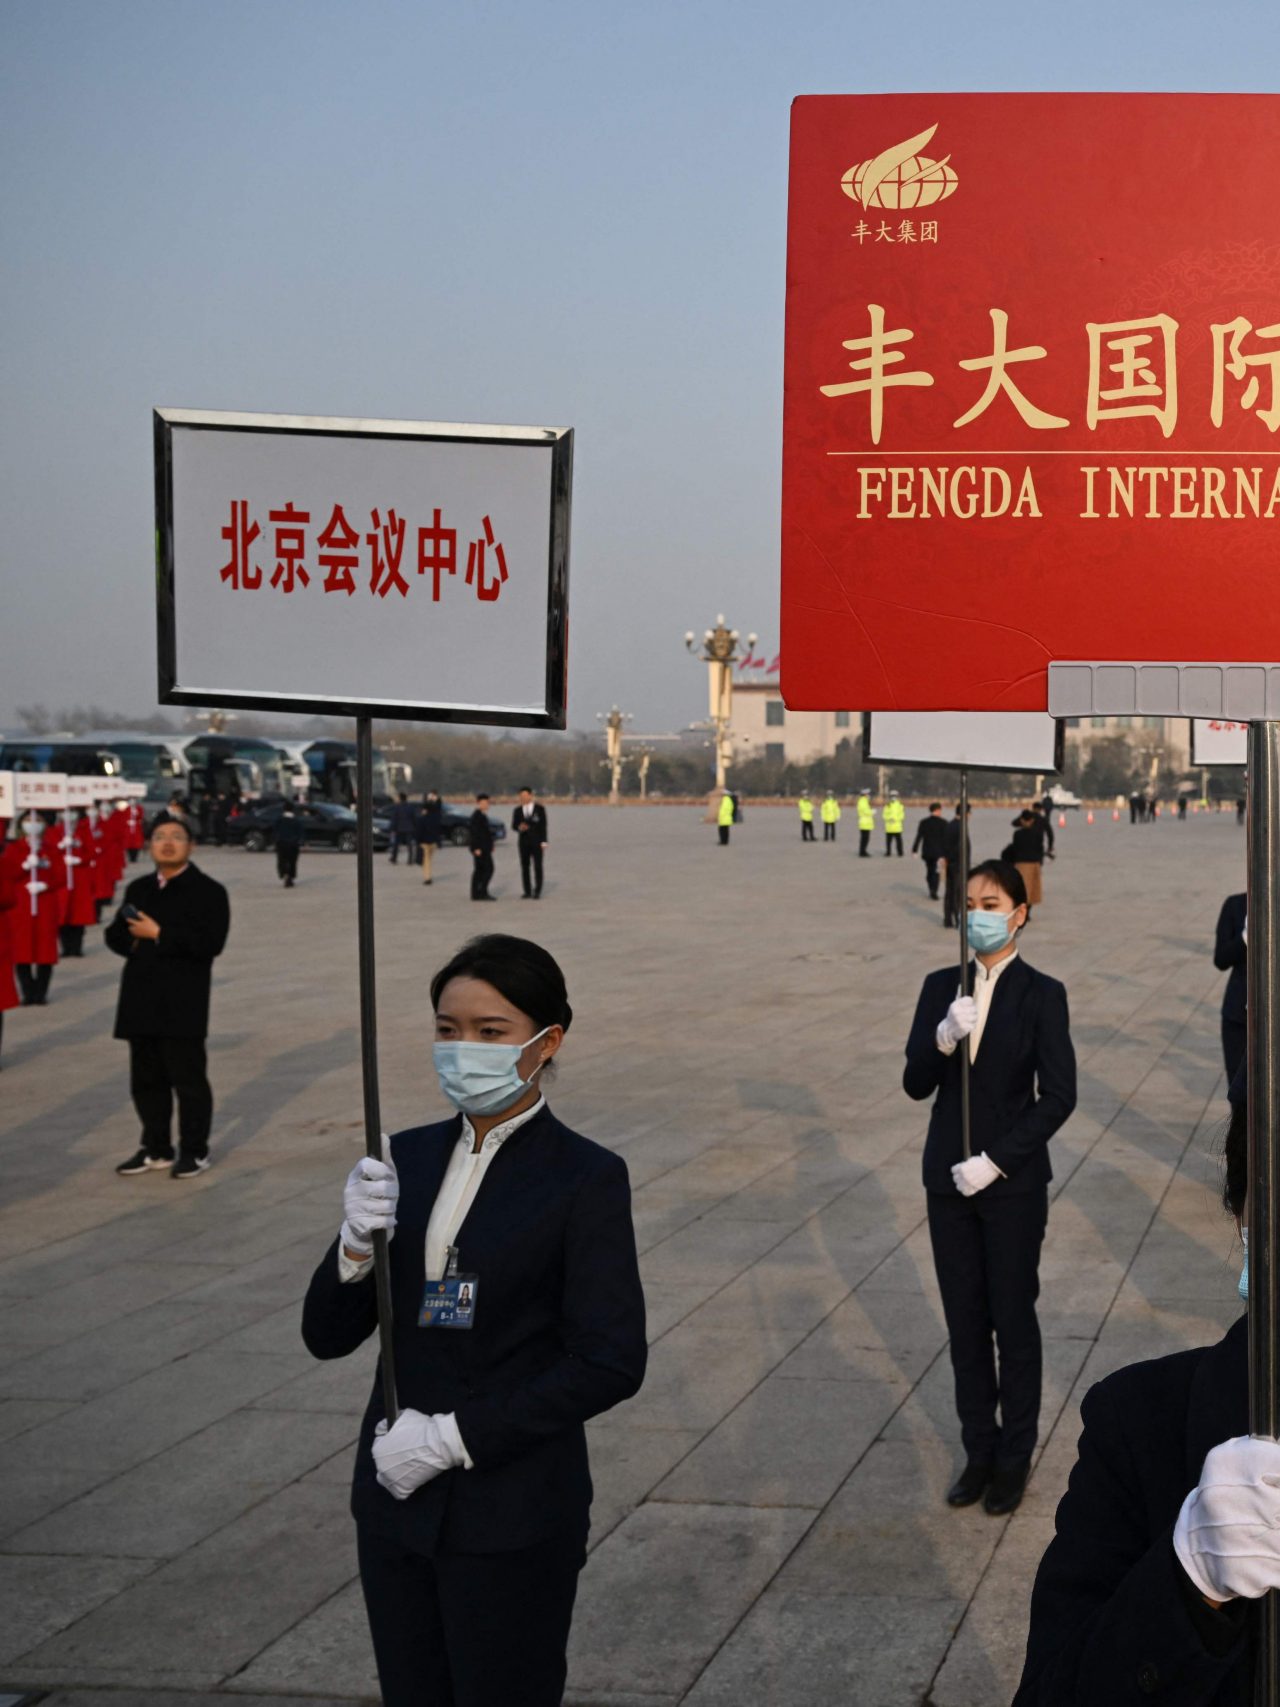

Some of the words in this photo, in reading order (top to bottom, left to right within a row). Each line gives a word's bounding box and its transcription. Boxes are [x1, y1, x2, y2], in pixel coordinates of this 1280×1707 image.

[851, 219, 938, 245] 丰大集团
[856, 466, 1043, 520] FENGDA
[220, 500, 509, 602] 北京会议中心
